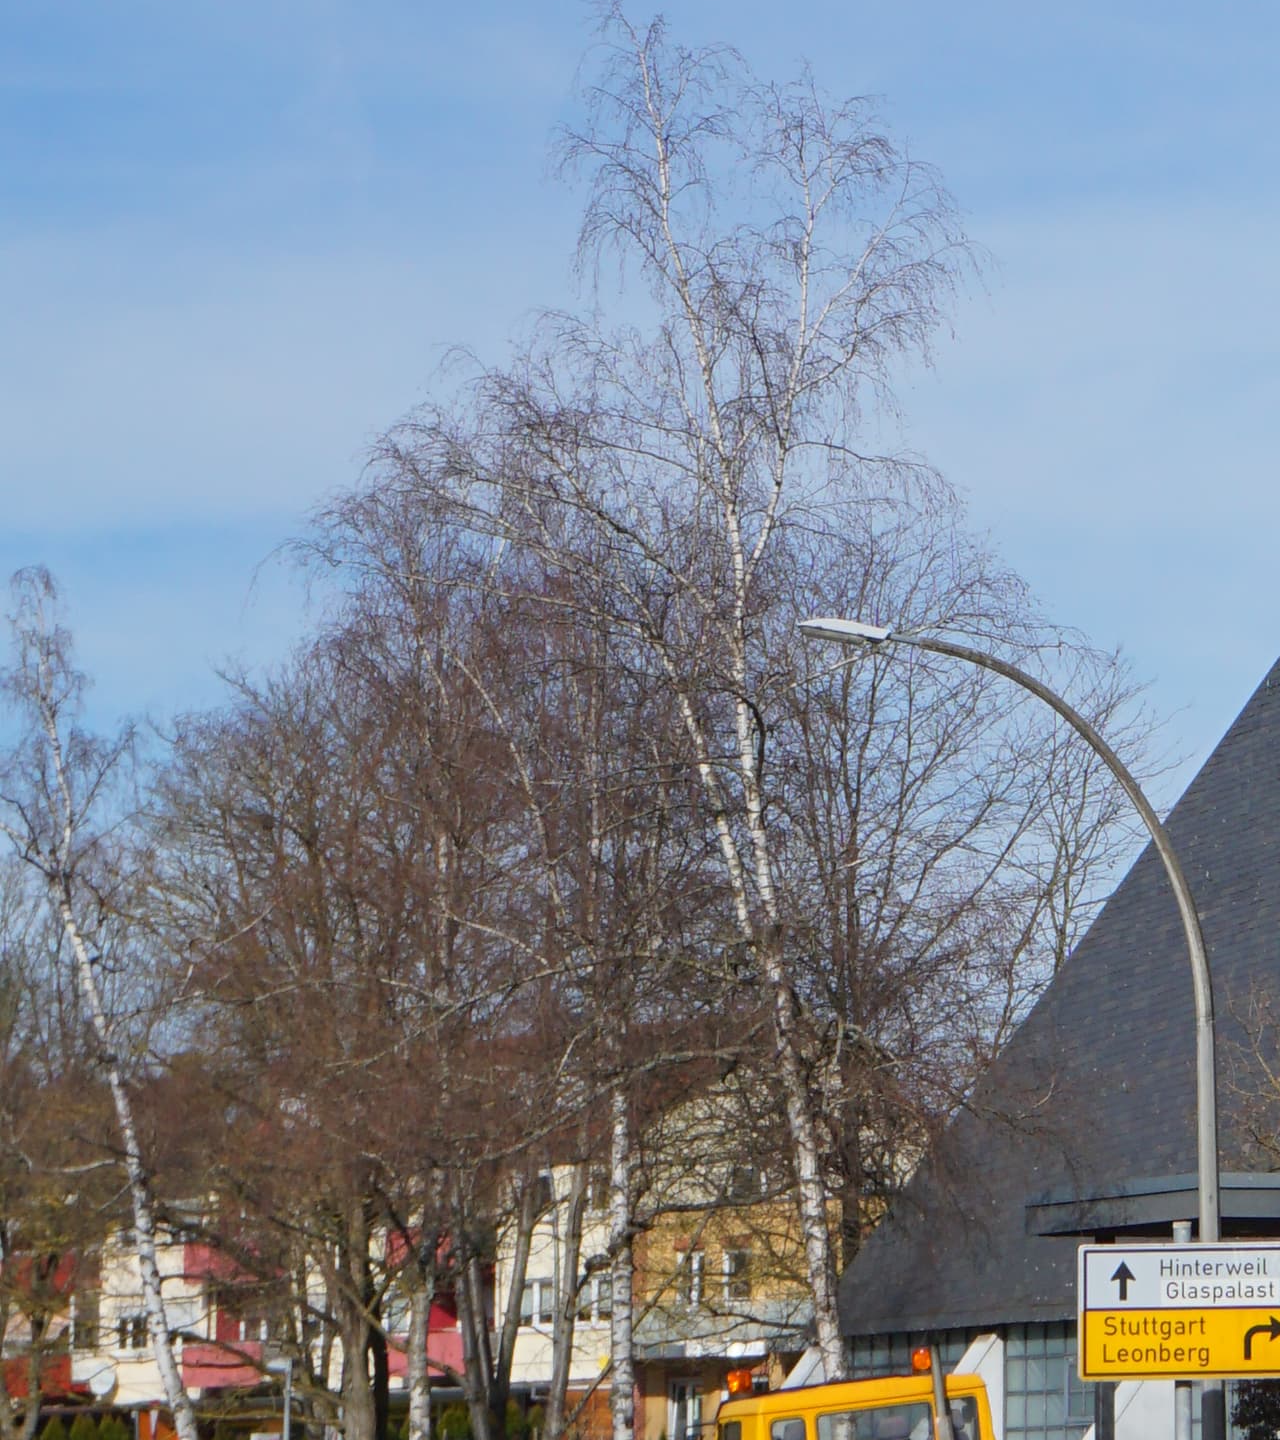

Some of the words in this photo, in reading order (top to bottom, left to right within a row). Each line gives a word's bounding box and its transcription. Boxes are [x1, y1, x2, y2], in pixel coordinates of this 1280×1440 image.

[1160, 1258, 1268, 1277] Hinterweil
[1166, 1281, 1275, 1303] Glaspalast
[1103, 1316, 1207, 1340] Stuttgart
[1102, 1343, 1210, 1367] Leonberg
